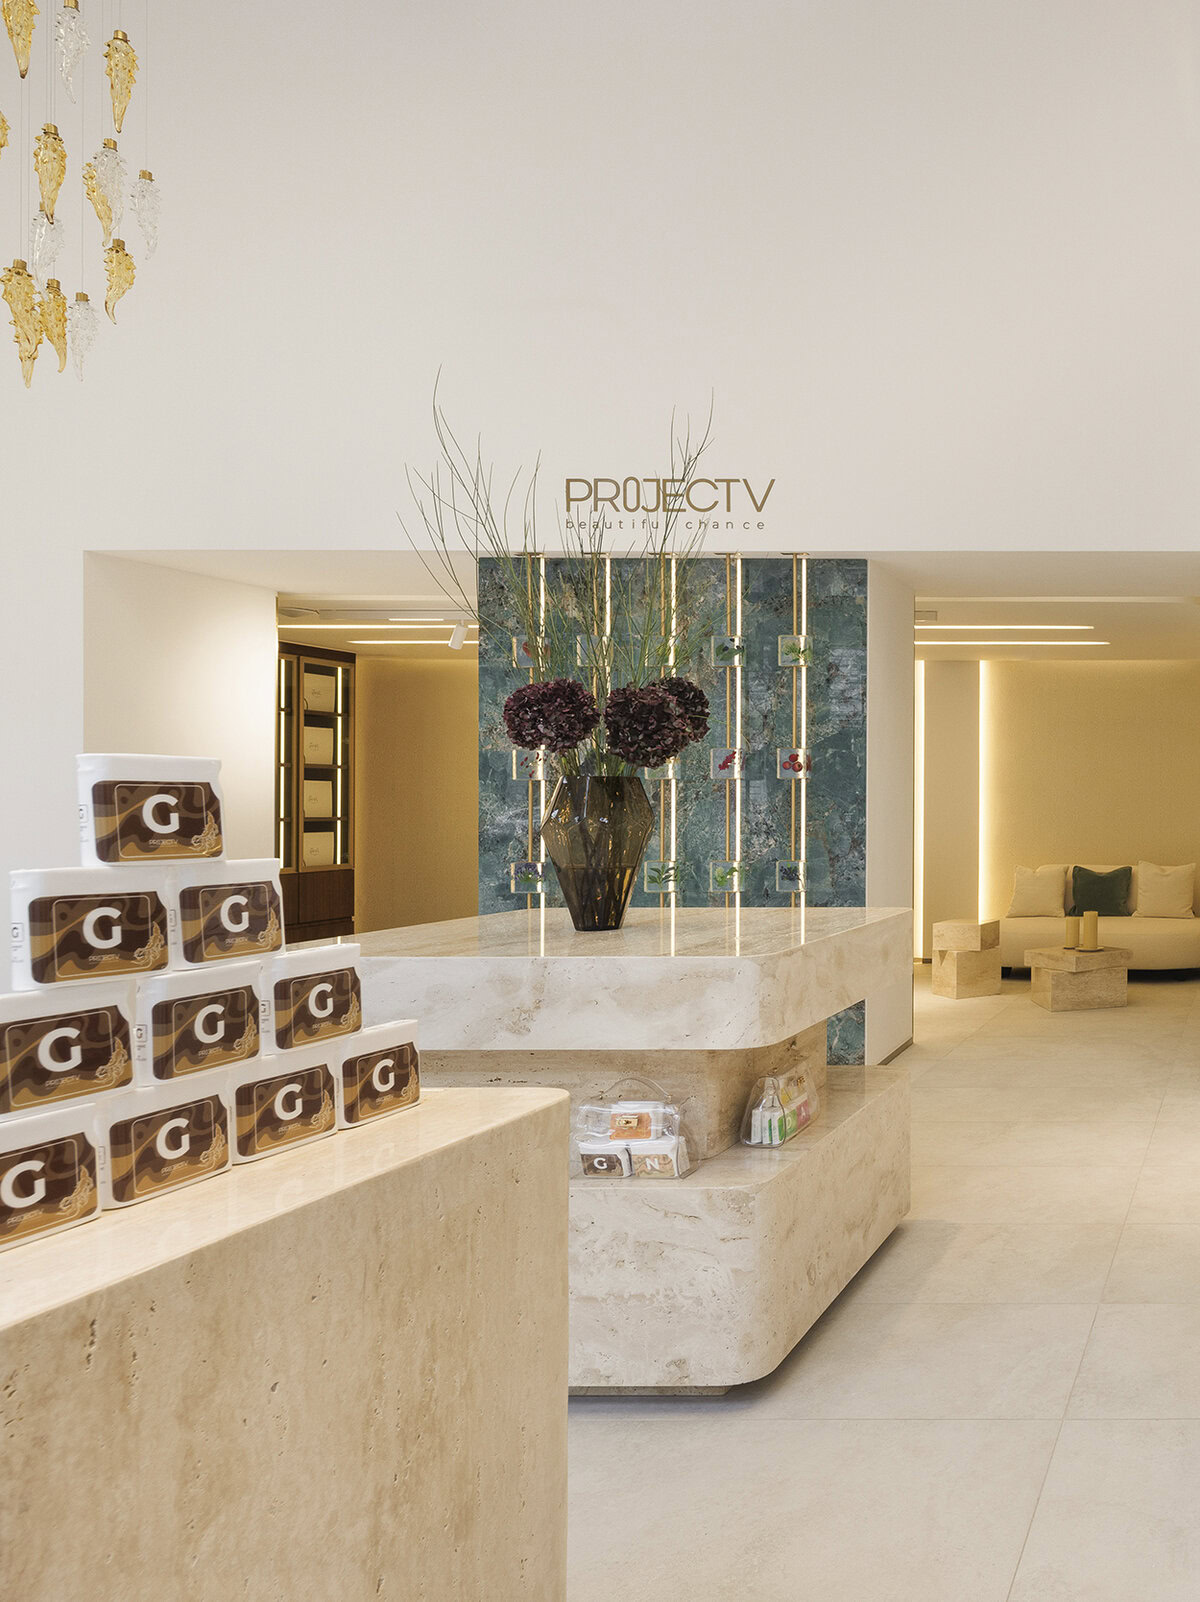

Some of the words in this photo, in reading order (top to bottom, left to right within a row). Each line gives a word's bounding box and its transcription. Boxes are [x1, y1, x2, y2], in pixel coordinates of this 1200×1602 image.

[566, 518, 669, 530] beautifu
[685, 518, 765, 530] chance
[142, 794, 180, 834] G
[82, 907, 122, 949] G
[220, 895, 249, 933] G
[308, 983, 333, 1018] G
[194, 1004, 225, 1044] G
[38, 1027, 82, 1072] G
[372, 1059, 395, 1092] G
[274, 1083, 303, 1121] G
[156, 1117, 190, 1160] G
[593, 1157, 608, 1169] G
[645, 1158, 660, 1170] N
[0, 1160, 46, 1209] G
